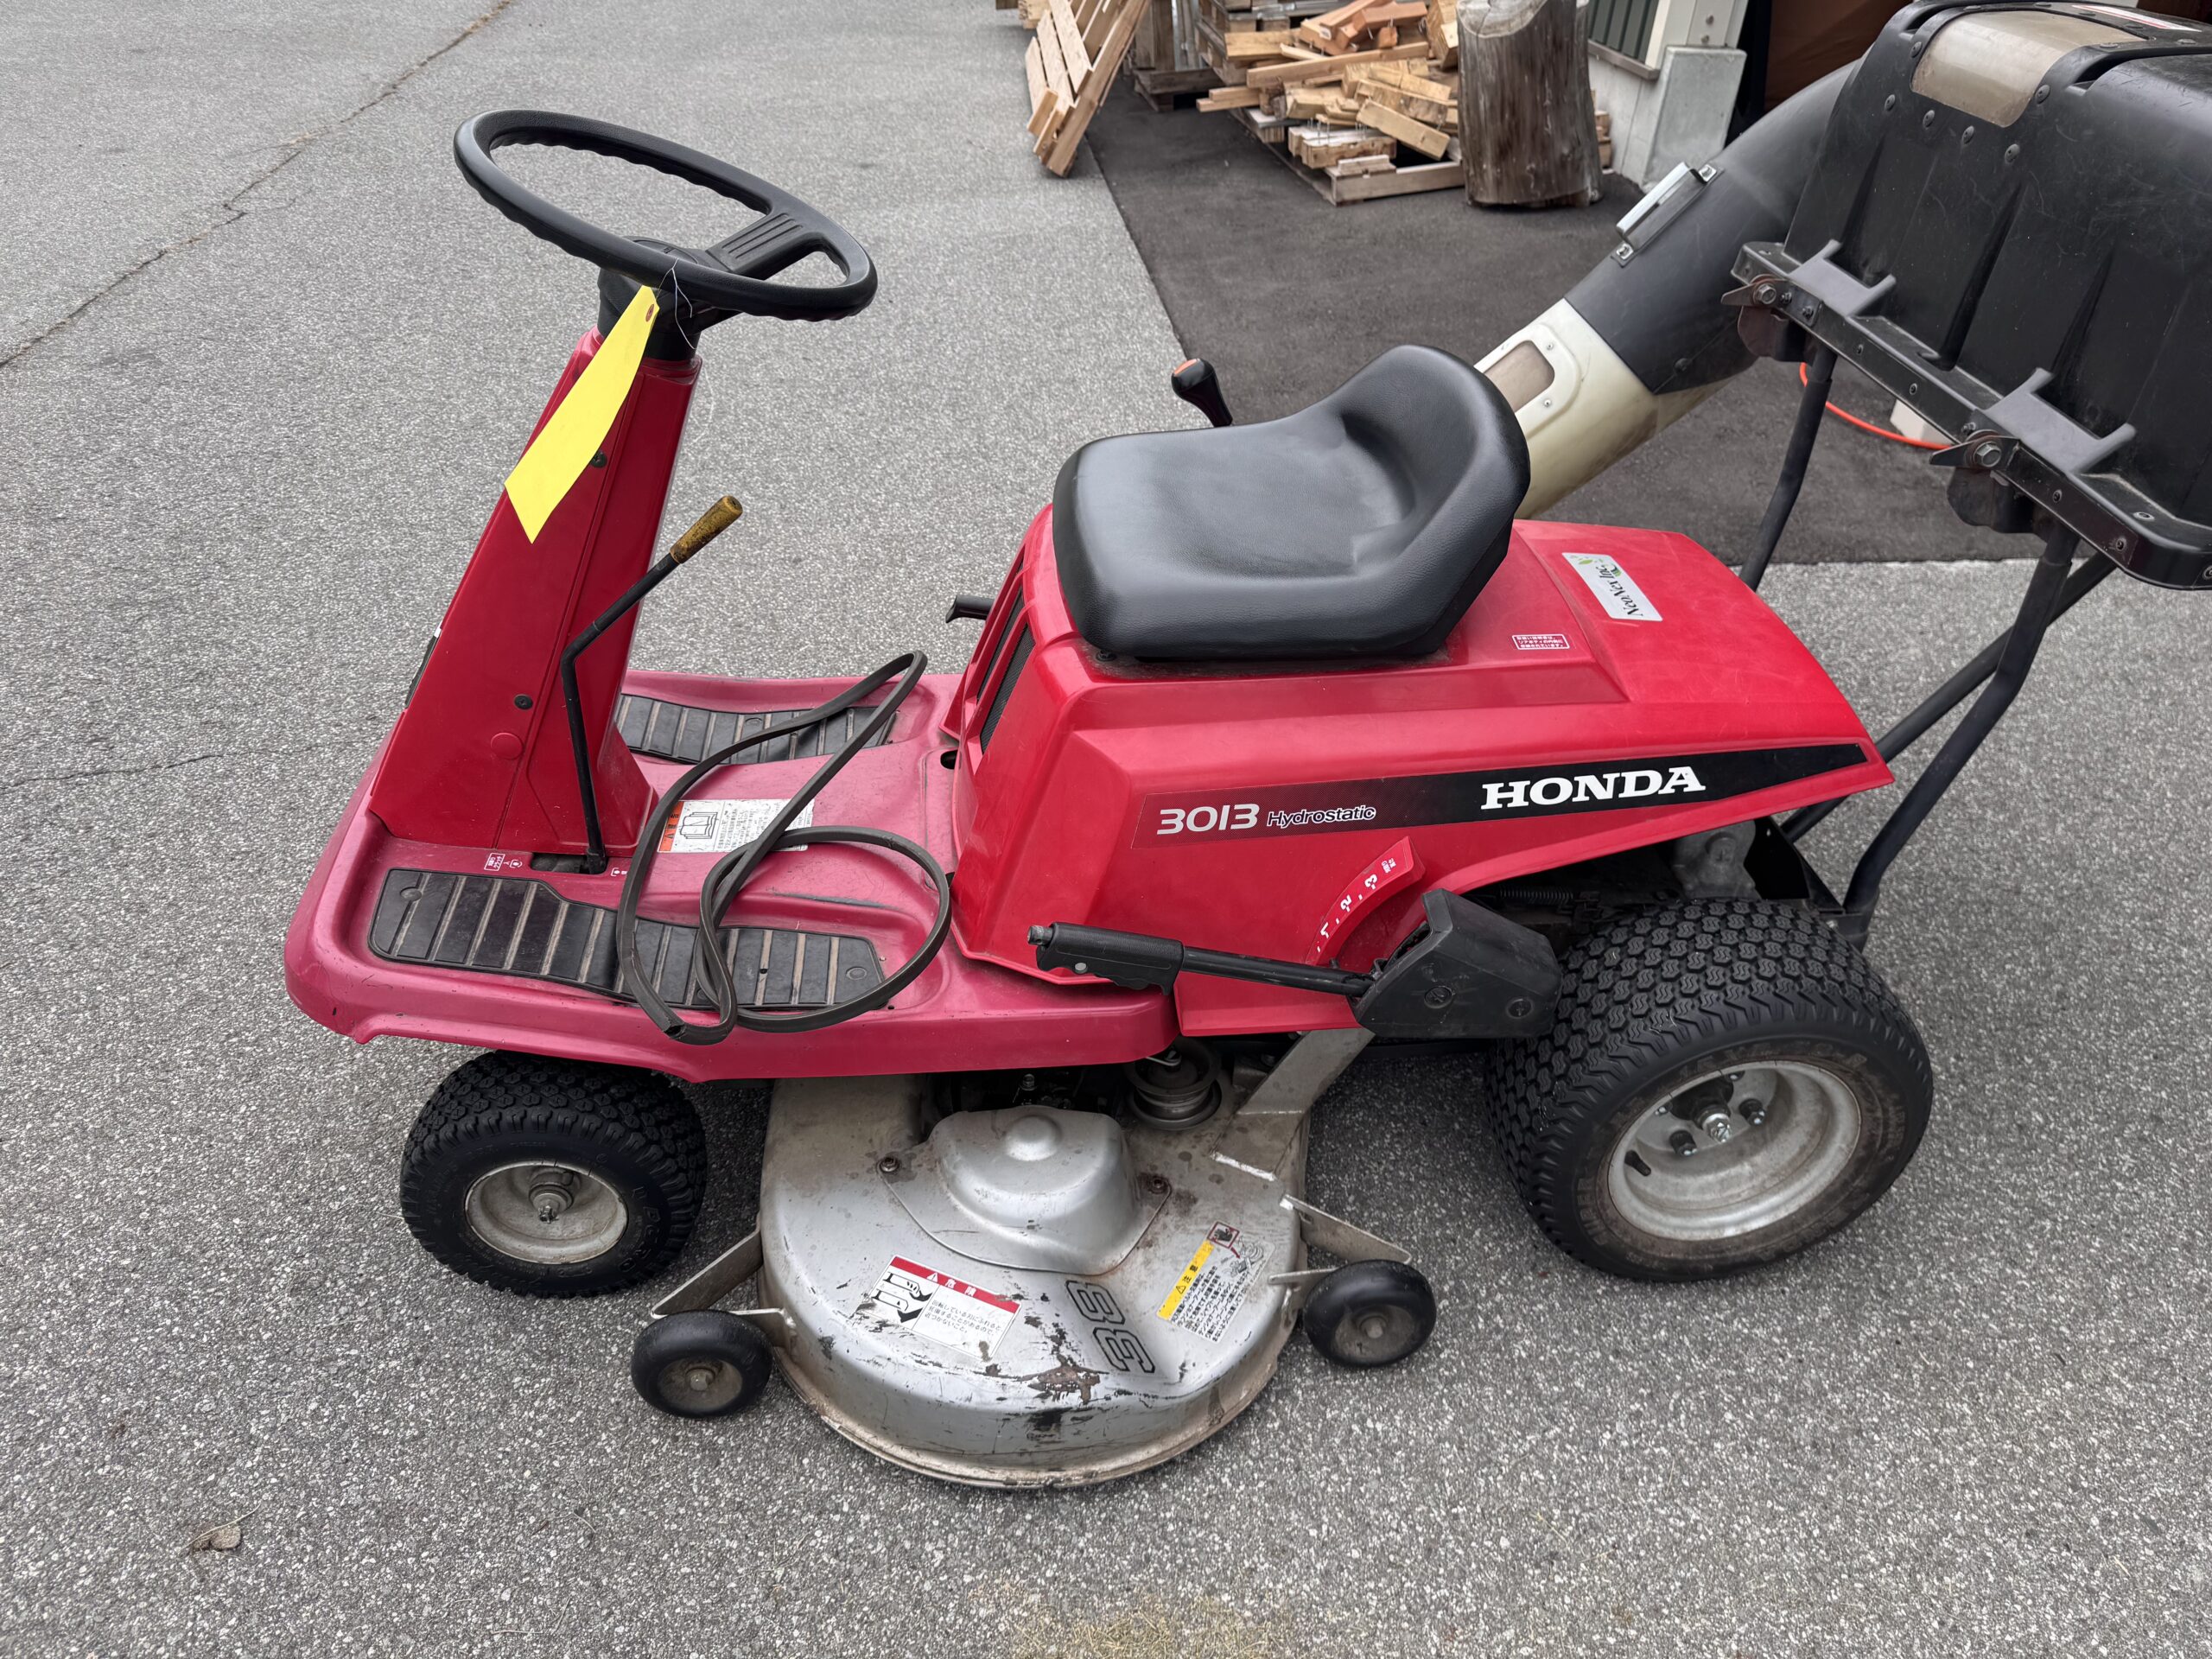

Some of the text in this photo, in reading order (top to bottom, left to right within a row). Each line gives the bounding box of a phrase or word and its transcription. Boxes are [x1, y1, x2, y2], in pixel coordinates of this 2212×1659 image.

[1480, 766, 1706, 810] HONDA
[1156, 804, 1376, 835] 3013 Hydrostatic
[1364, 874, 1378, 887] 3
[1340, 894, 1352, 910] 2
[944, 1278, 976, 1297] 危険
[1065, 1279, 1156, 1374] 38
